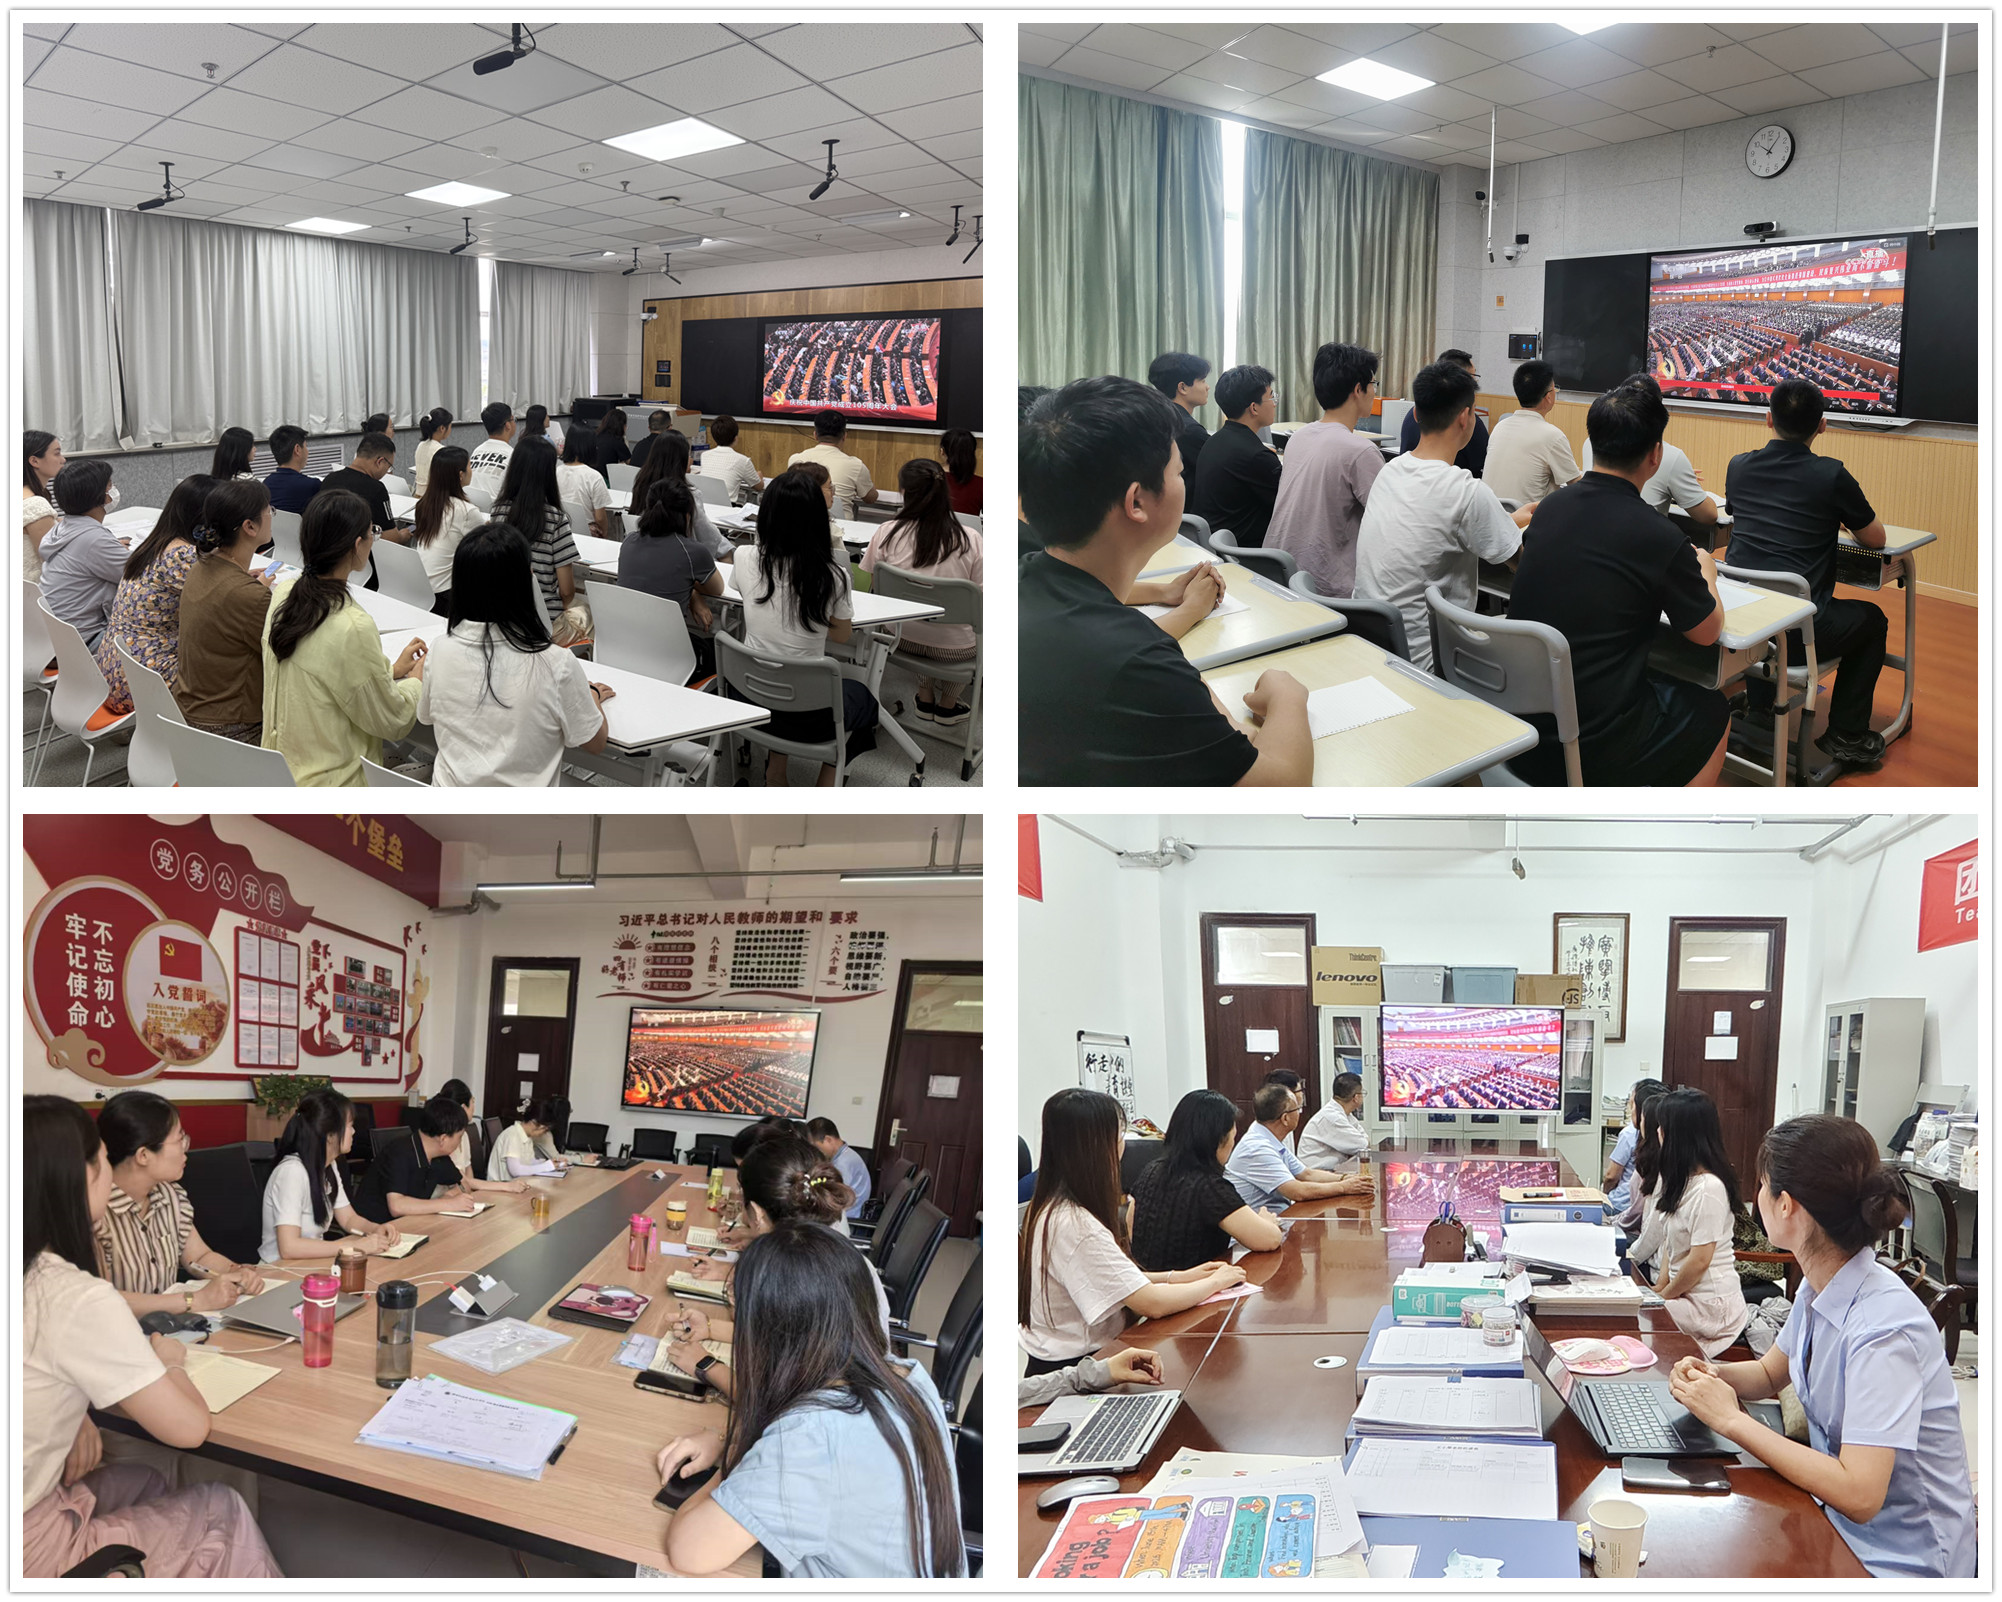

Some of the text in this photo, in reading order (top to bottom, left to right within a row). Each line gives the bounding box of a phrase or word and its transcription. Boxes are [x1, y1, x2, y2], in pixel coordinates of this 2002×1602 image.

[789, 399, 898, 411] 庆祝中国共产党成立105周年大会
[335, 814, 404, 872] 个堡垒
[156, 846, 281, 912] 党务公开栏
[1955, 906, 1978, 924] Te
[65, 913, 90, 1027] 牢记使命
[707, 936, 720, 978] 八个相统一
[828, 946, 841, 976] 六个要
[92, 919, 115, 1029] 不忘初心
[1316, 971, 1378, 982] lenovo
[152, 982, 208, 1004] 入党誓词
[1082, 1562, 1101, 1571] a
